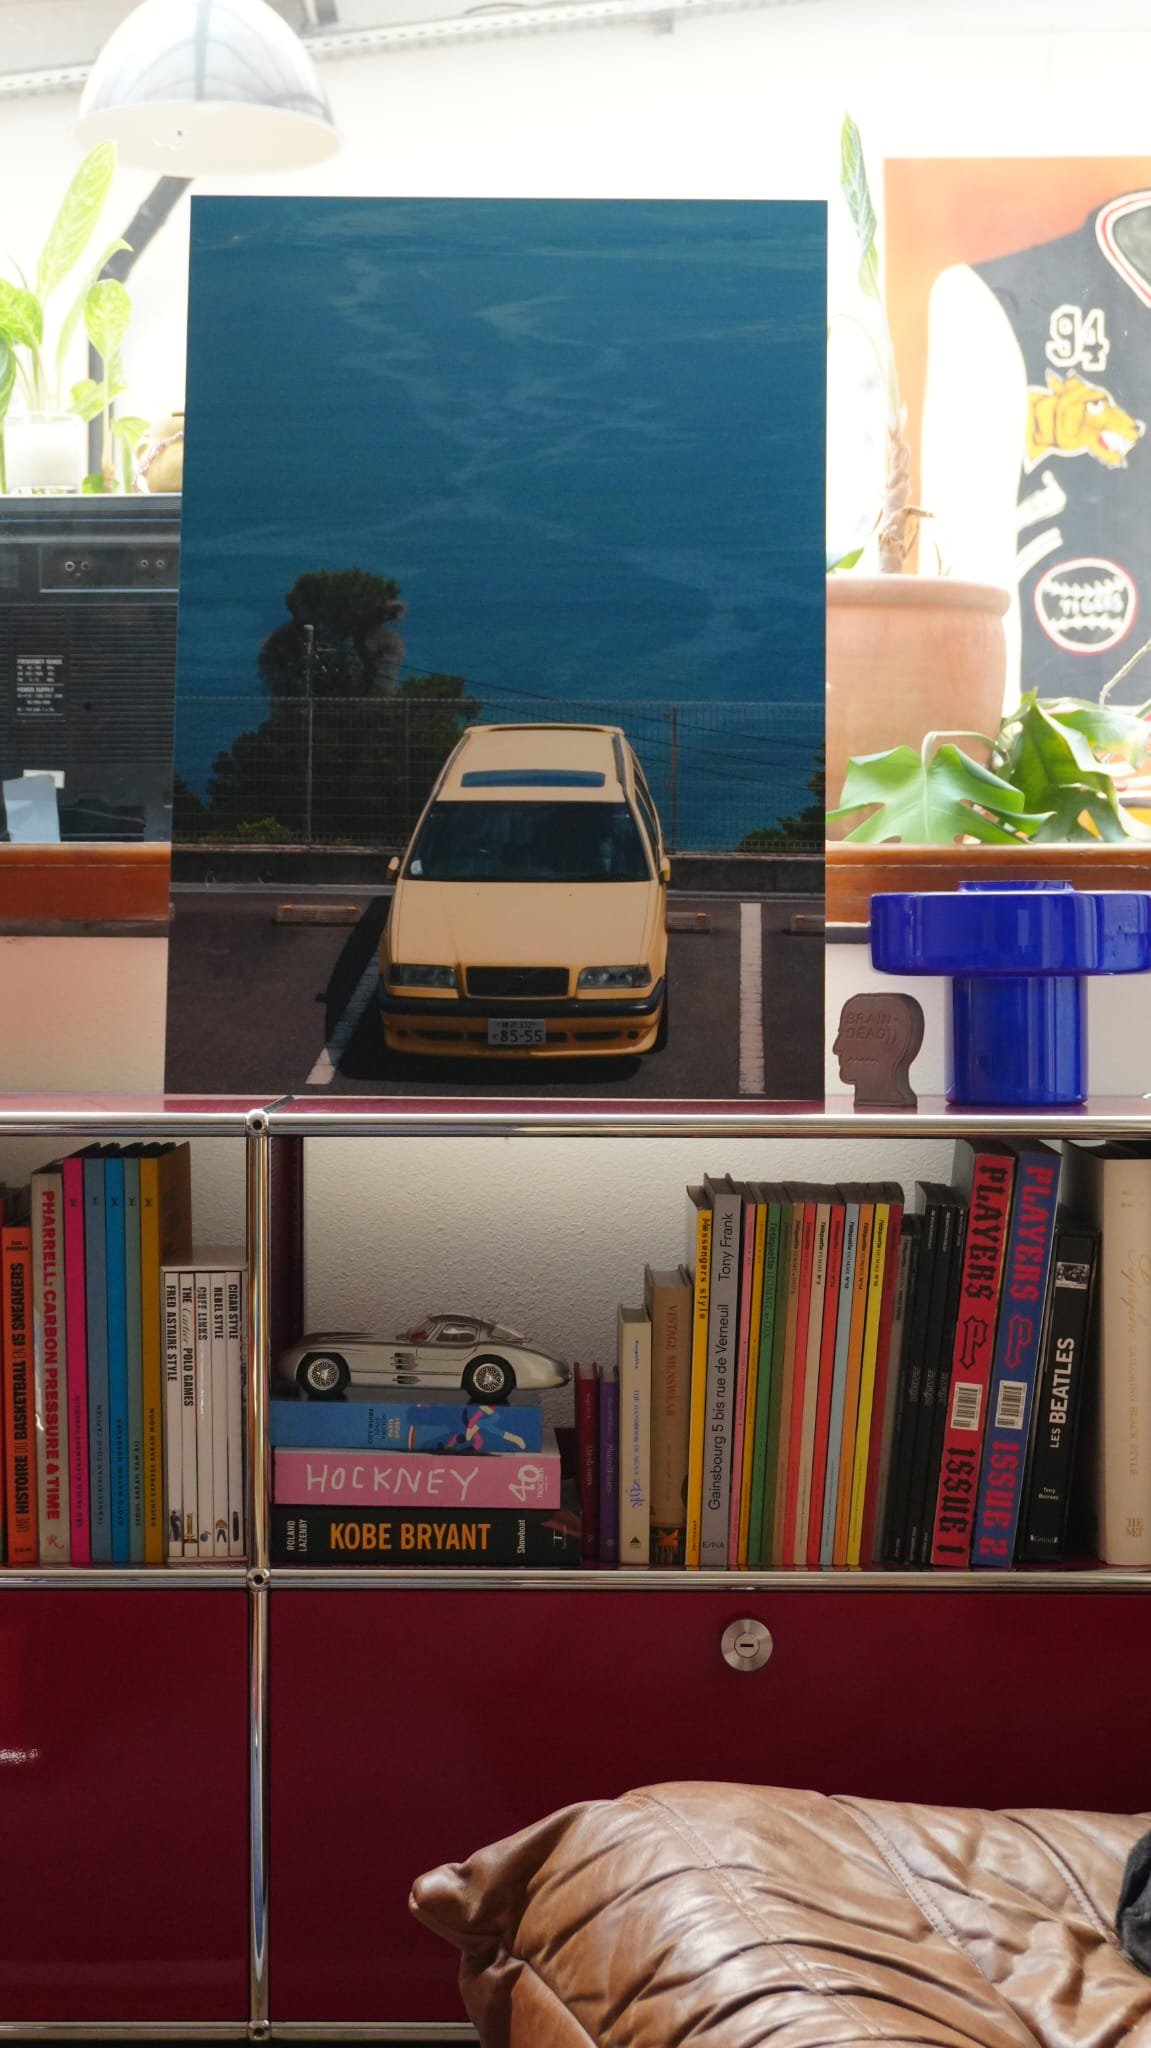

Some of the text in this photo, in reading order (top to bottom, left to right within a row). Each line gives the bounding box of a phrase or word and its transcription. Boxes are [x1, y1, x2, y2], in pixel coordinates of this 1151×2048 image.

[1045, 304, 1110, 371] 94
[500, 1029, 543, 1042] 85-55
[847, 1012, 892, 1025] BRAIN
[718, 1213, 735, 1282] Tony Frank
[964, 1165, 1009, 1301] PLAYERS
[1009, 1165, 1054, 1302] PLAYERS
[11, 1264, 25, 1330] SNEAKERS
[182, 1286, 192, 1303] THE
[697, 1218, 711, 1319] Messengers style
[12, 1333, 25, 1346] 15
[167, 1285, 178, 1382] FRED ASTAIRE STYLE
[197, 1287, 208, 1341] CUFF LINKS
[214, 1287, 224, 1340] REBEL STYLE
[228, 1284, 239, 1340] CIGAR STYLE
[43, 1190, 60, 1520] PHARRELL: CARBON PRESSURE & TIME
[183, 1347, 193, 1372] POLO
[12, 1361, 27, 1440] BASKETBALL
[183, 1375, 194, 1407] GAMES
[707, 1304, 729, 1510] Gainsbourg 5 bis rue de Verneuil
[1048, 1337, 1075, 1448] LES BEATLES
[14, 1456, 28, 1514] HISTOIRE
[306, 1462, 479, 1502] HOCKNEY
[936, 1448, 977, 1555] ISSUE 1
[979, 1441, 1022, 1556] ISSUE 2
[286, 1520, 296, 1551] ROLAND
[298, 1519, 308, 1552] LAZENBY
[330, 1522, 492, 1551] KOBE BRYANT
[516, 1519, 526, 1555] Showboat
